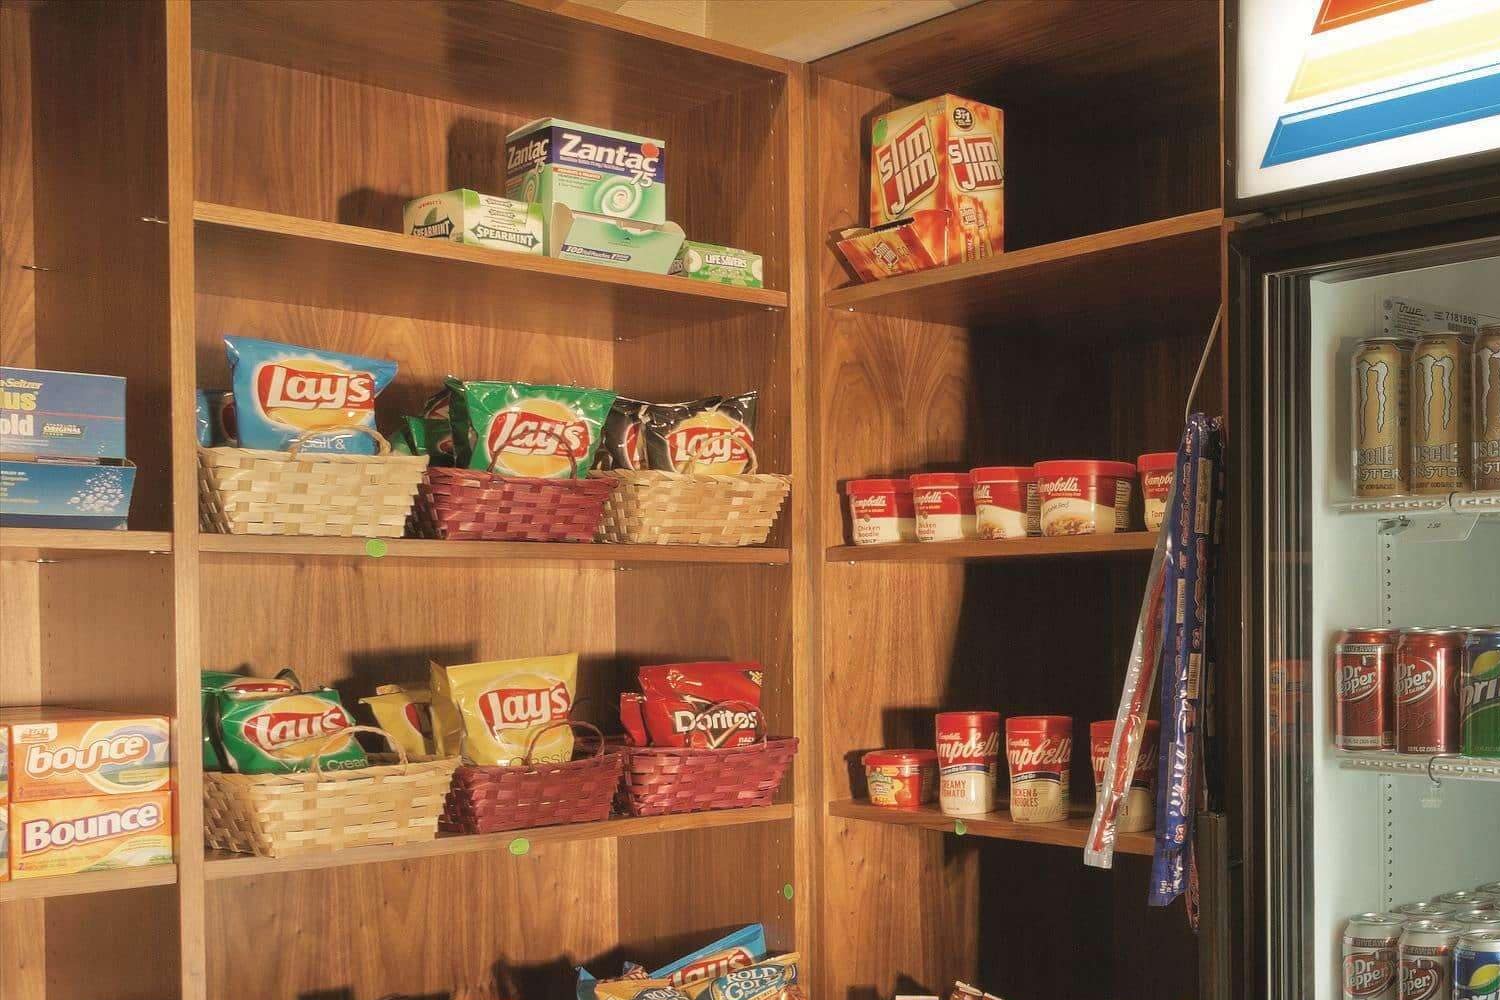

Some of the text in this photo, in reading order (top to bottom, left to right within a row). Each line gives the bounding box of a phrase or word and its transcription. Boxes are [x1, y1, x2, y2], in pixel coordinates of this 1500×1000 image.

[508, 139, 549, 170] Zantac
[560, 134, 660, 173] Zantac
[630, 170, 657, 188] 75
[476, 225, 534, 247] SPEARMINT
[675, 710, 758, 733] Doritos
[27, 734, 145, 774] bounce
[24, 804, 158, 853] Bounce
